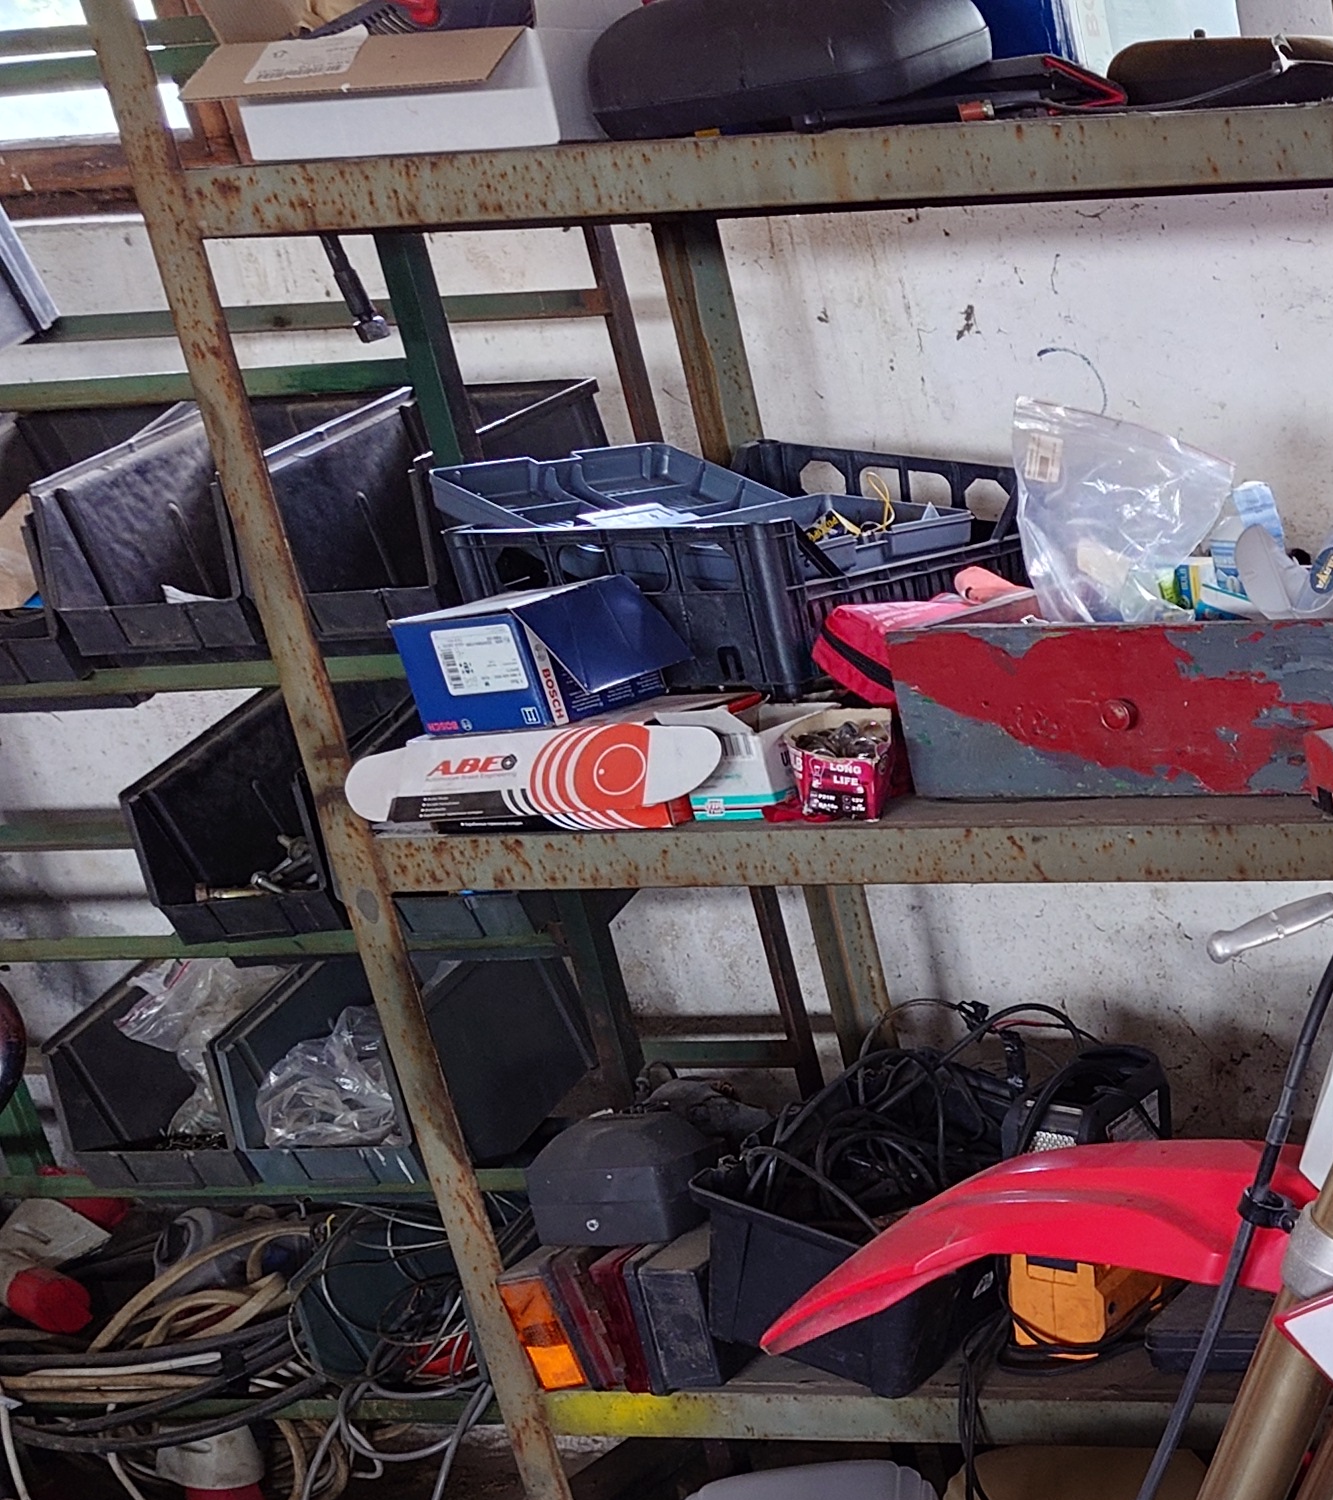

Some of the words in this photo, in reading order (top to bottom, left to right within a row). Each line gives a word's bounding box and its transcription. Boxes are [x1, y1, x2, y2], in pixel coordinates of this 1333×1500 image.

[541, 668, 565, 720] BOSCH
[427, 721, 460, 731] BOSCH
[427, 755, 506, 777] ABE
[829, 762, 862, 775] LONG
[833, 774, 859, 786] LIFE
